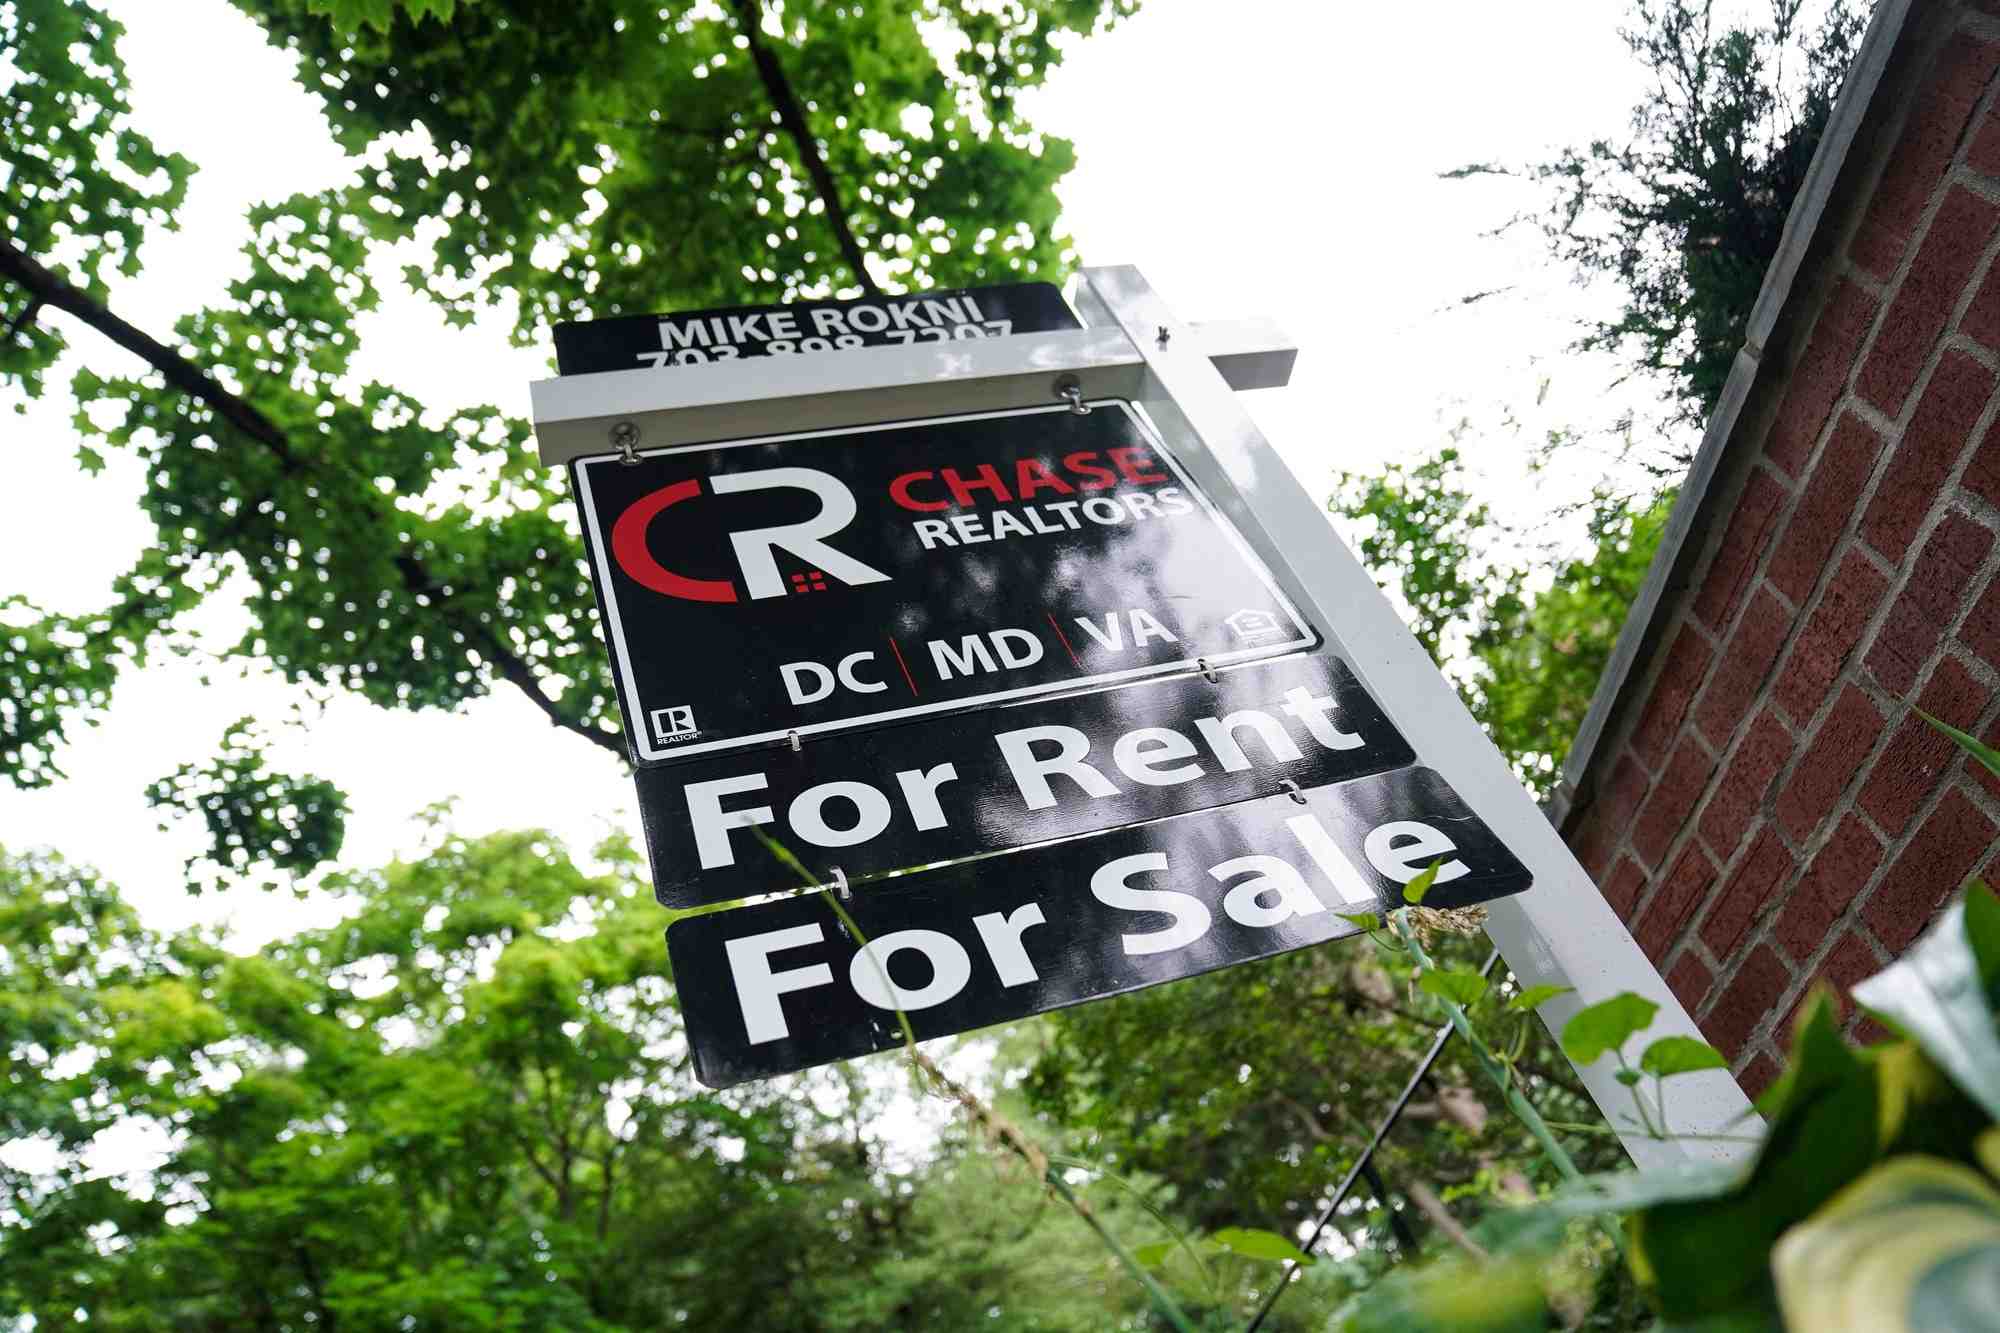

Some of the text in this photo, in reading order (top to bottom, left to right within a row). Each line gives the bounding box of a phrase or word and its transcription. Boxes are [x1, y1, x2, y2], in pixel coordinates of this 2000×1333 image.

[658, 296, 984, 350] MIKE ROKNI
[889, 447, 1169, 512] CHASE
[912, 487, 1195, 550] REALTORS
[611, 466, 893, 603] CR
[779, 607, 1178, 705] DC MD VA
[682, 684, 1366, 871] For Rent
[723, 814, 1472, 1046] For Sale
